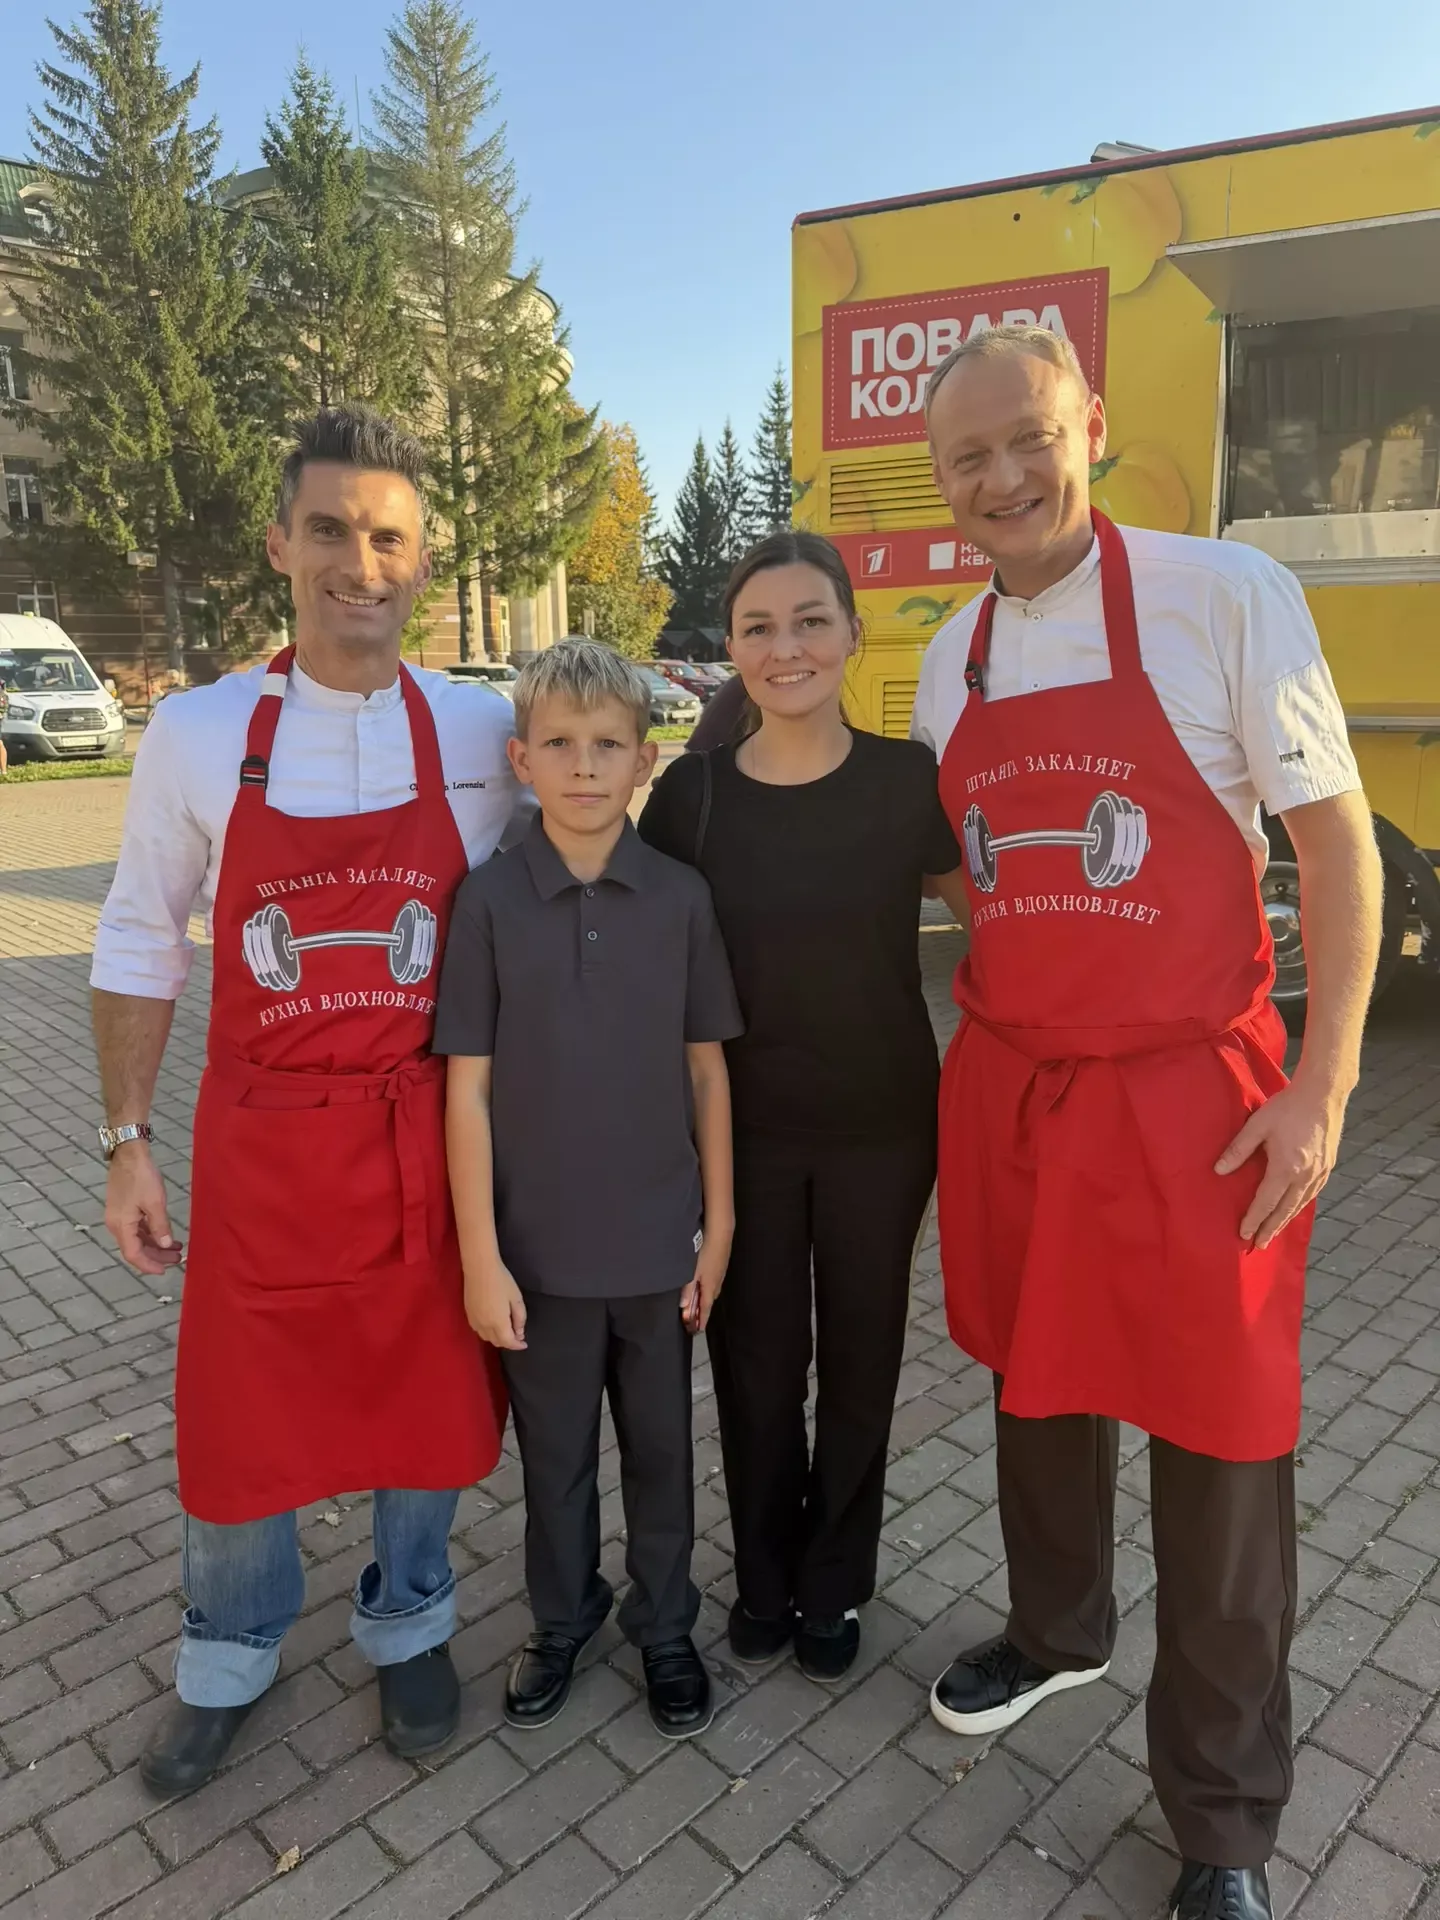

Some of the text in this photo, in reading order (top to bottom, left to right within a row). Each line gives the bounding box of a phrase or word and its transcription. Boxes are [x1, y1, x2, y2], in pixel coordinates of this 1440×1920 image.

[965, 753, 1137, 794] ШТАНГА ЗАКАЛЯЕТ
[256, 866, 436, 898] ШТАНГА ЗАКАЛЯЕТ
[1013, 894, 1161, 925] ВДОХНОВЛЯЕТ
[259, 990, 436, 1027] КУХНЯ ВДОХНОВЛЯЕ
